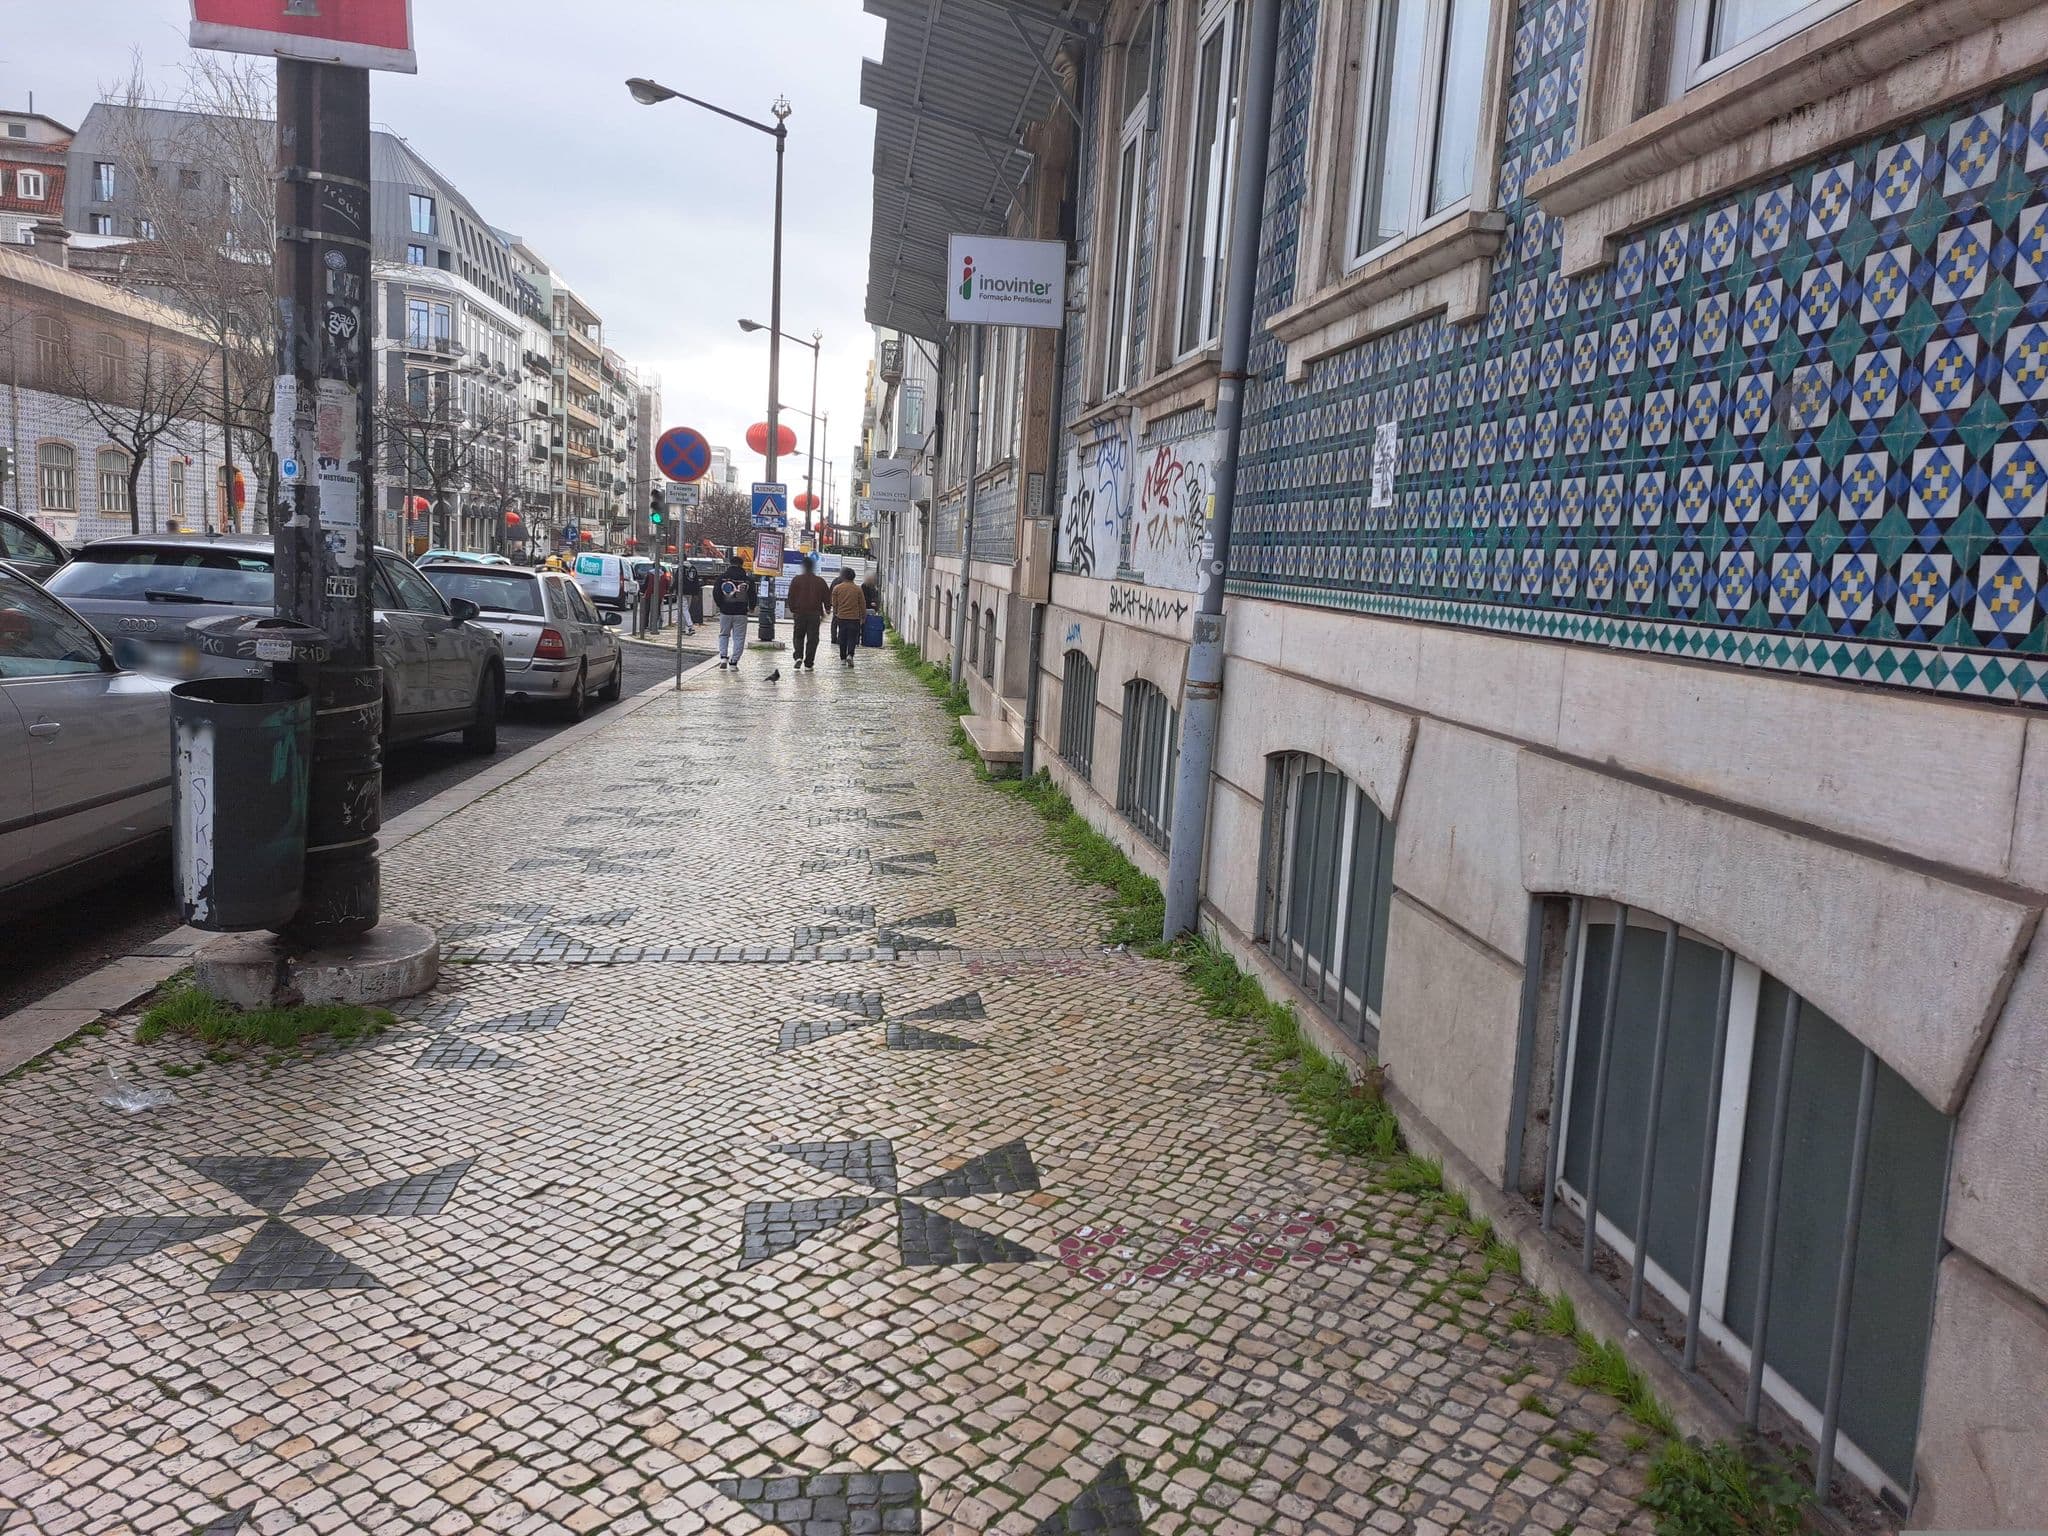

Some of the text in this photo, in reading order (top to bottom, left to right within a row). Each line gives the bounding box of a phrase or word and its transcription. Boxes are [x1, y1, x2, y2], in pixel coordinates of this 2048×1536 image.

[979, 275, 1052, 296] inovinter
[979, 293, 1052, 305] Formação Profissional
[755, 485, 784, 493] ATENÇÃO
